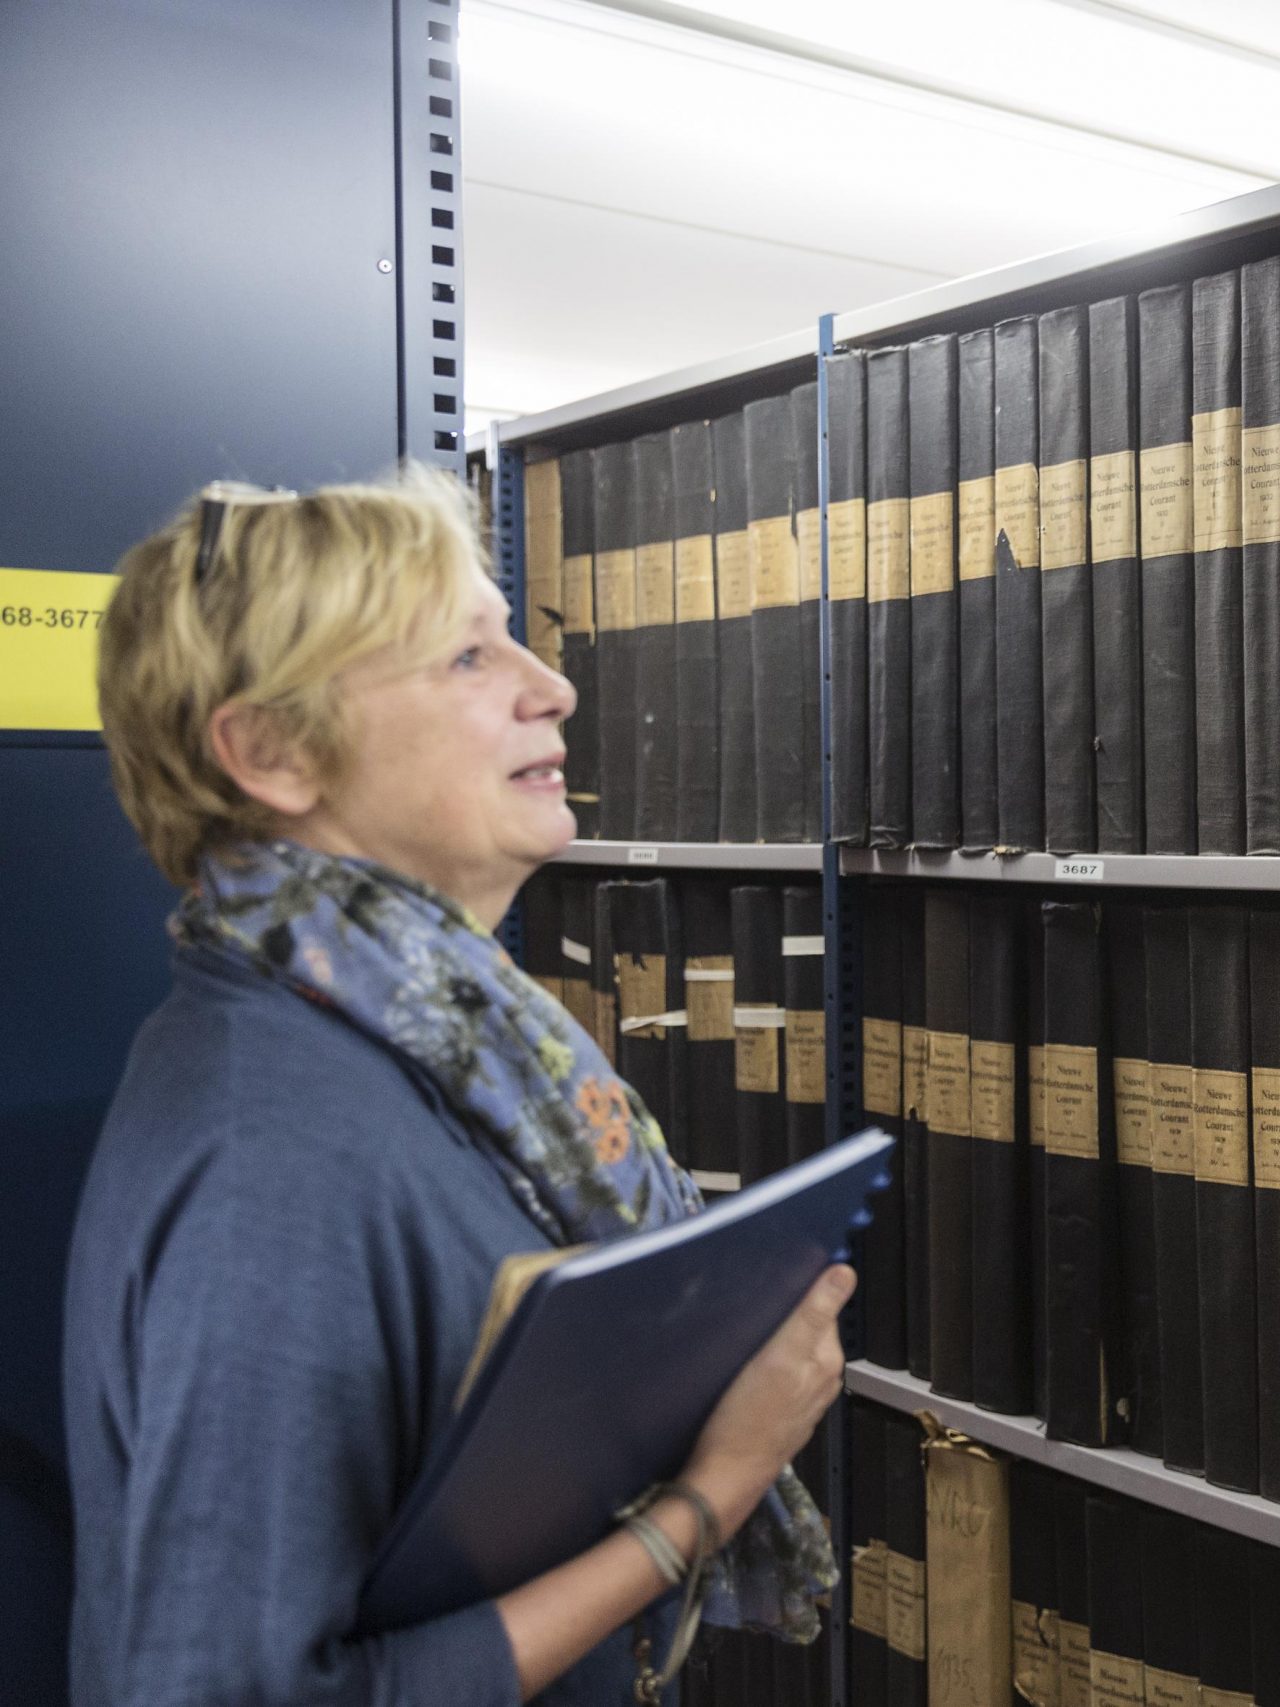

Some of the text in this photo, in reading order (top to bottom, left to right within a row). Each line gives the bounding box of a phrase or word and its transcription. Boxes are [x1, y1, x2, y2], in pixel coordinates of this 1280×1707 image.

[1251, 446, 1280, 458] Nieuwe
[1250, 477, 1280, 490] Courant
[1150, 495, 1176, 506] Courant
[1062, 865, 1097, 874] 3687
[1205, 1120, 1234, 1132] Courant
